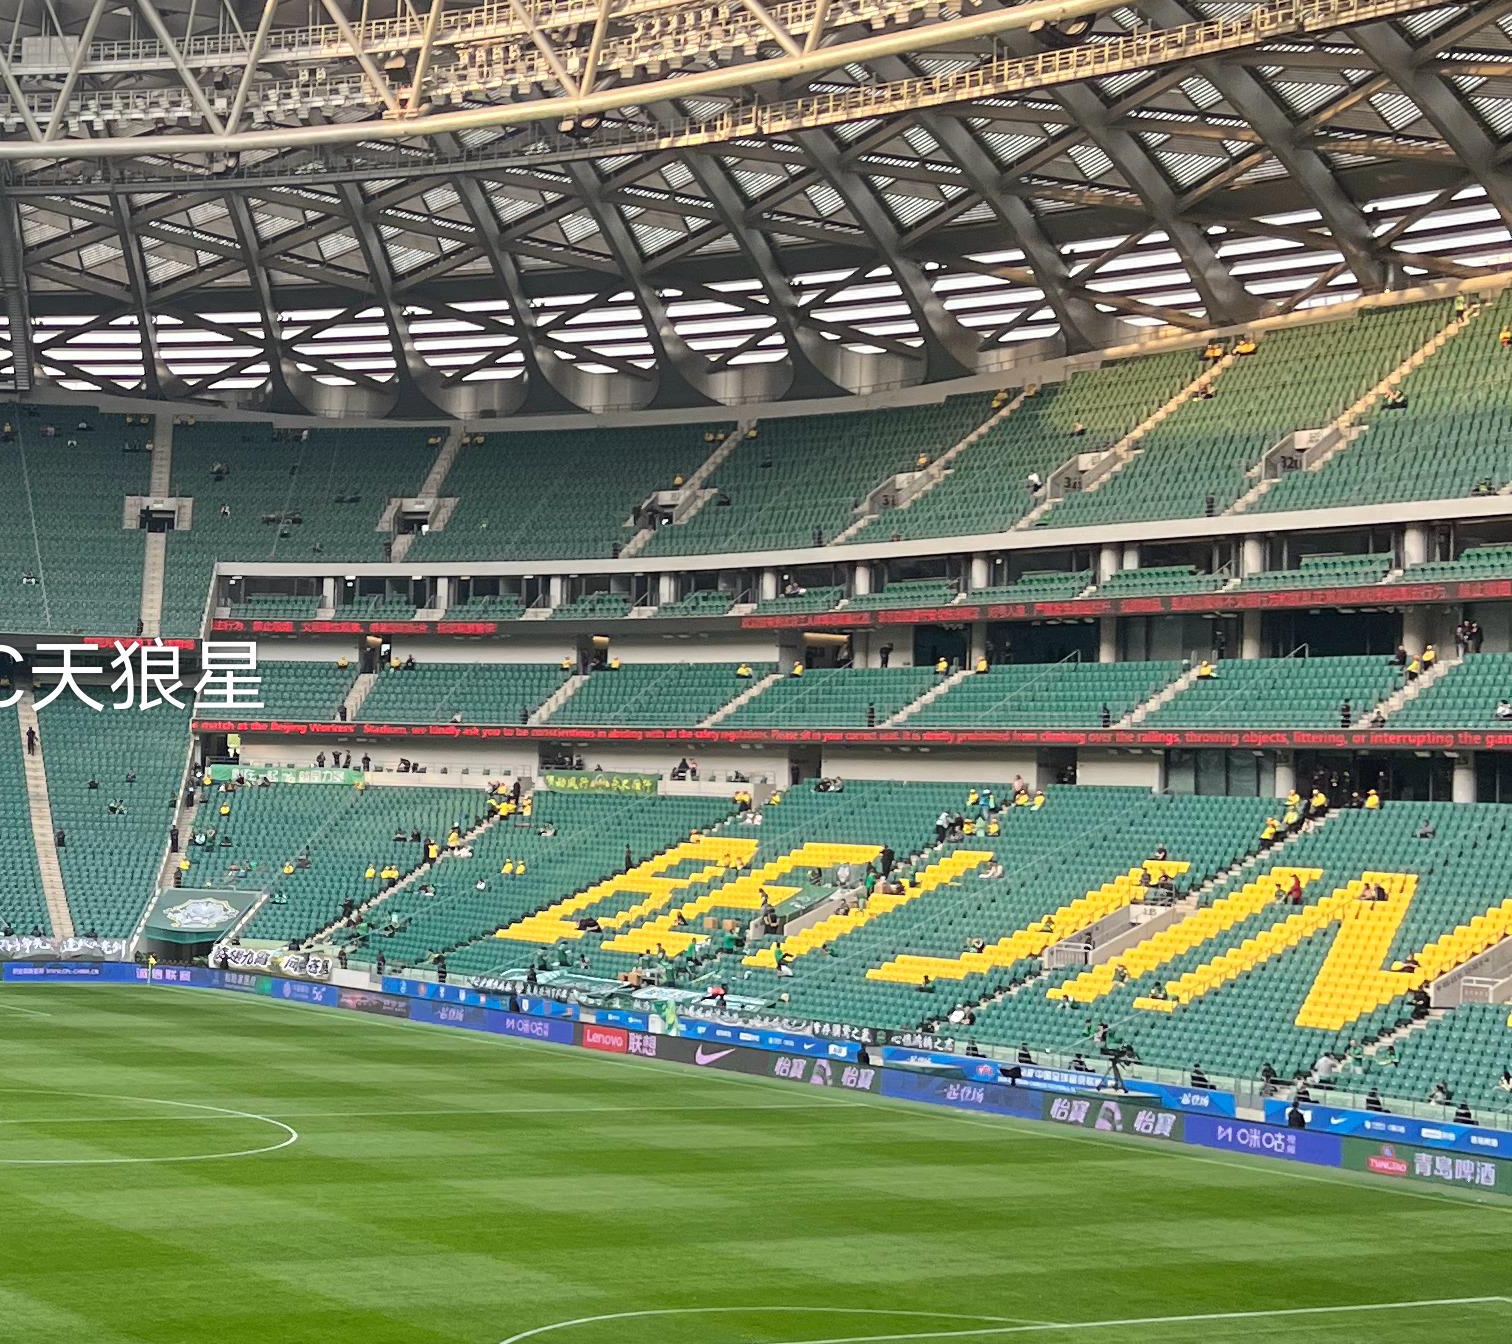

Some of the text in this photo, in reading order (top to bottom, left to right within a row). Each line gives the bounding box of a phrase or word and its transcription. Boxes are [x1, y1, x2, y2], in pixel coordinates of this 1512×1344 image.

[251, 721, 268, 731] the
[270, 721, 307, 735] Beijing
[482, 728, 501, 739] you
[1089, 733, 1112, 743] over
[1116, 731, 1134, 743] the
[1185, 731, 1239, 746] throwing
[1242, 731, 1290, 746] objects,
[1293, 732, 1348, 747] littering,
[1352, 734, 1366, 743] or
[1370, 732, 1454, 747] interrupting
[1458, 732, 1481, 744] the
[586, 1029, 657, 1056] Lenovo 联想
[1050, 1098, 1090, 1123] 怡寶
[1134, 1110, 1177, 1137] 怡寶
